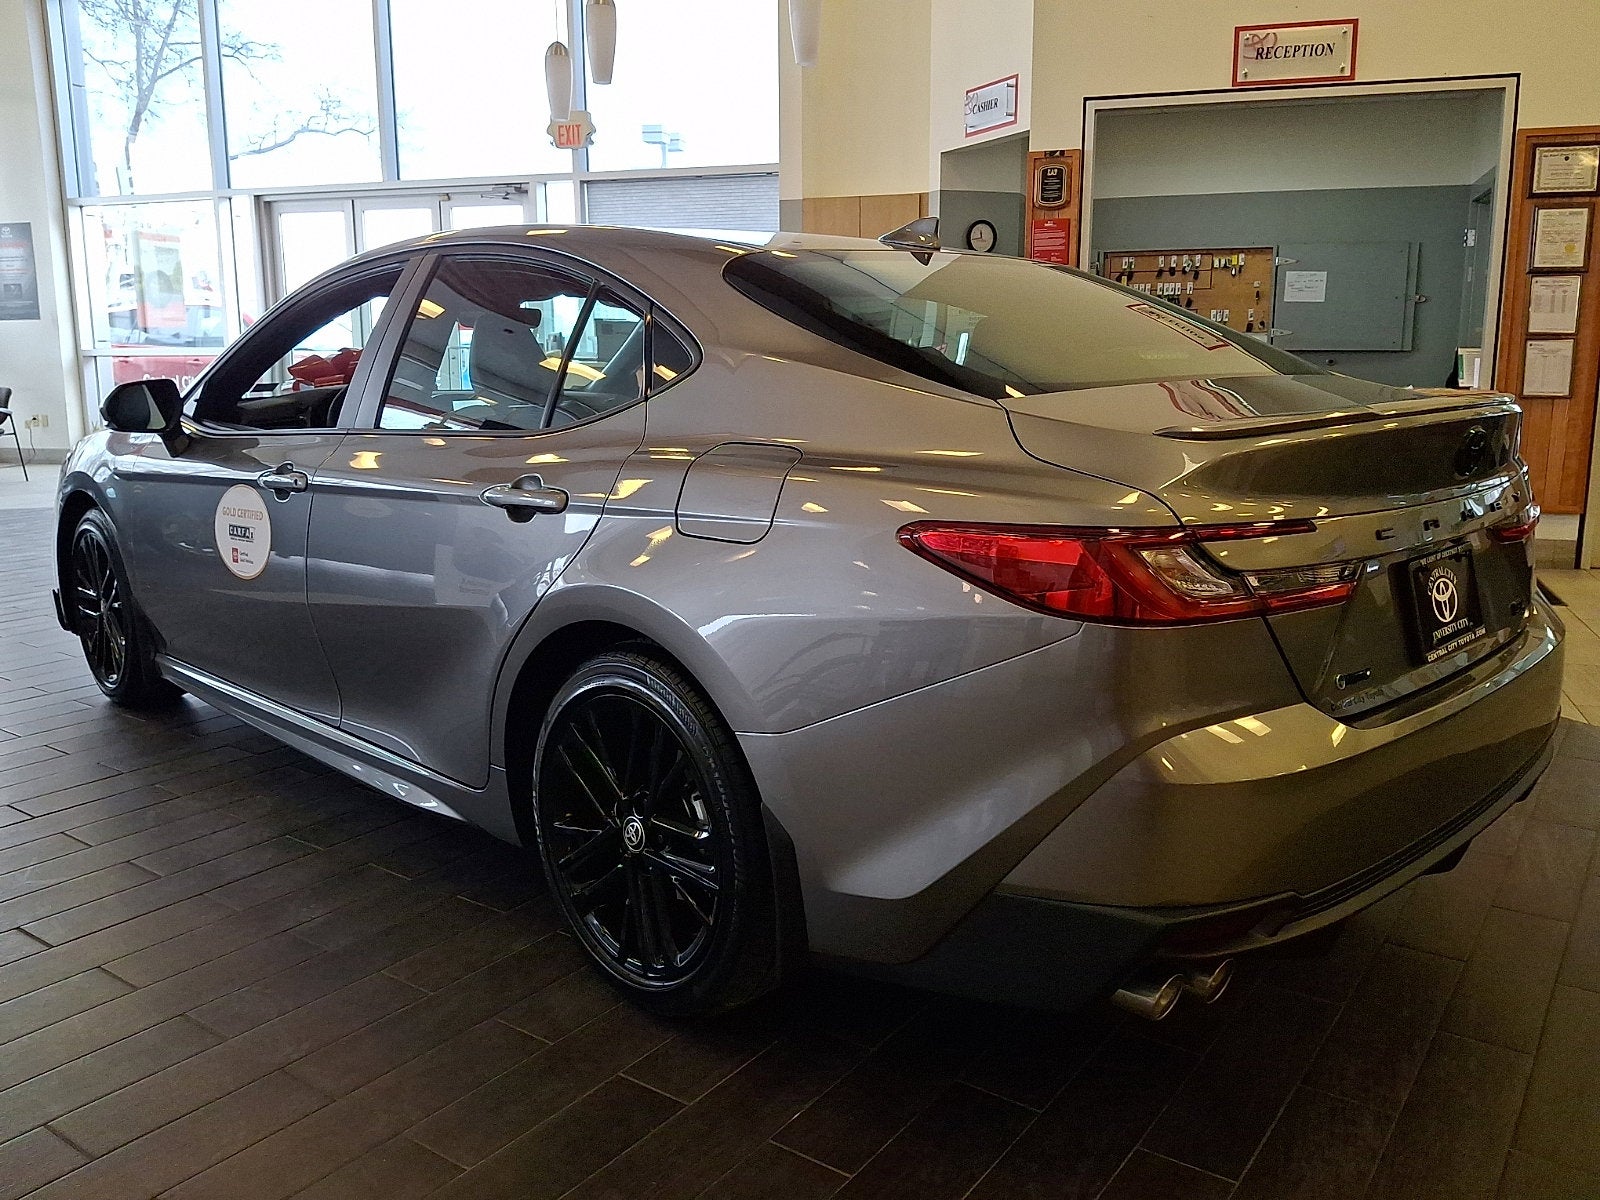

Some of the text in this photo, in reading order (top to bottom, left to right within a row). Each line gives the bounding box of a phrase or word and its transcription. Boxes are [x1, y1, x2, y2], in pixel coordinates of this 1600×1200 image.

[1255, 42, 1336, 60] RECEPTION
[972, 97, 999, 115] CASHIER
[557, 123, 582, 146] EXIT
[222, 506, 264, 521] GOLD CERTIFIED
[229, 524, 255, 539] CARFA
[1427, 647, 1448, 662] CENTRAL
[1447, 641, 1458, 652] CITY
[1458, 633, 1476, 646] TOYOTA
